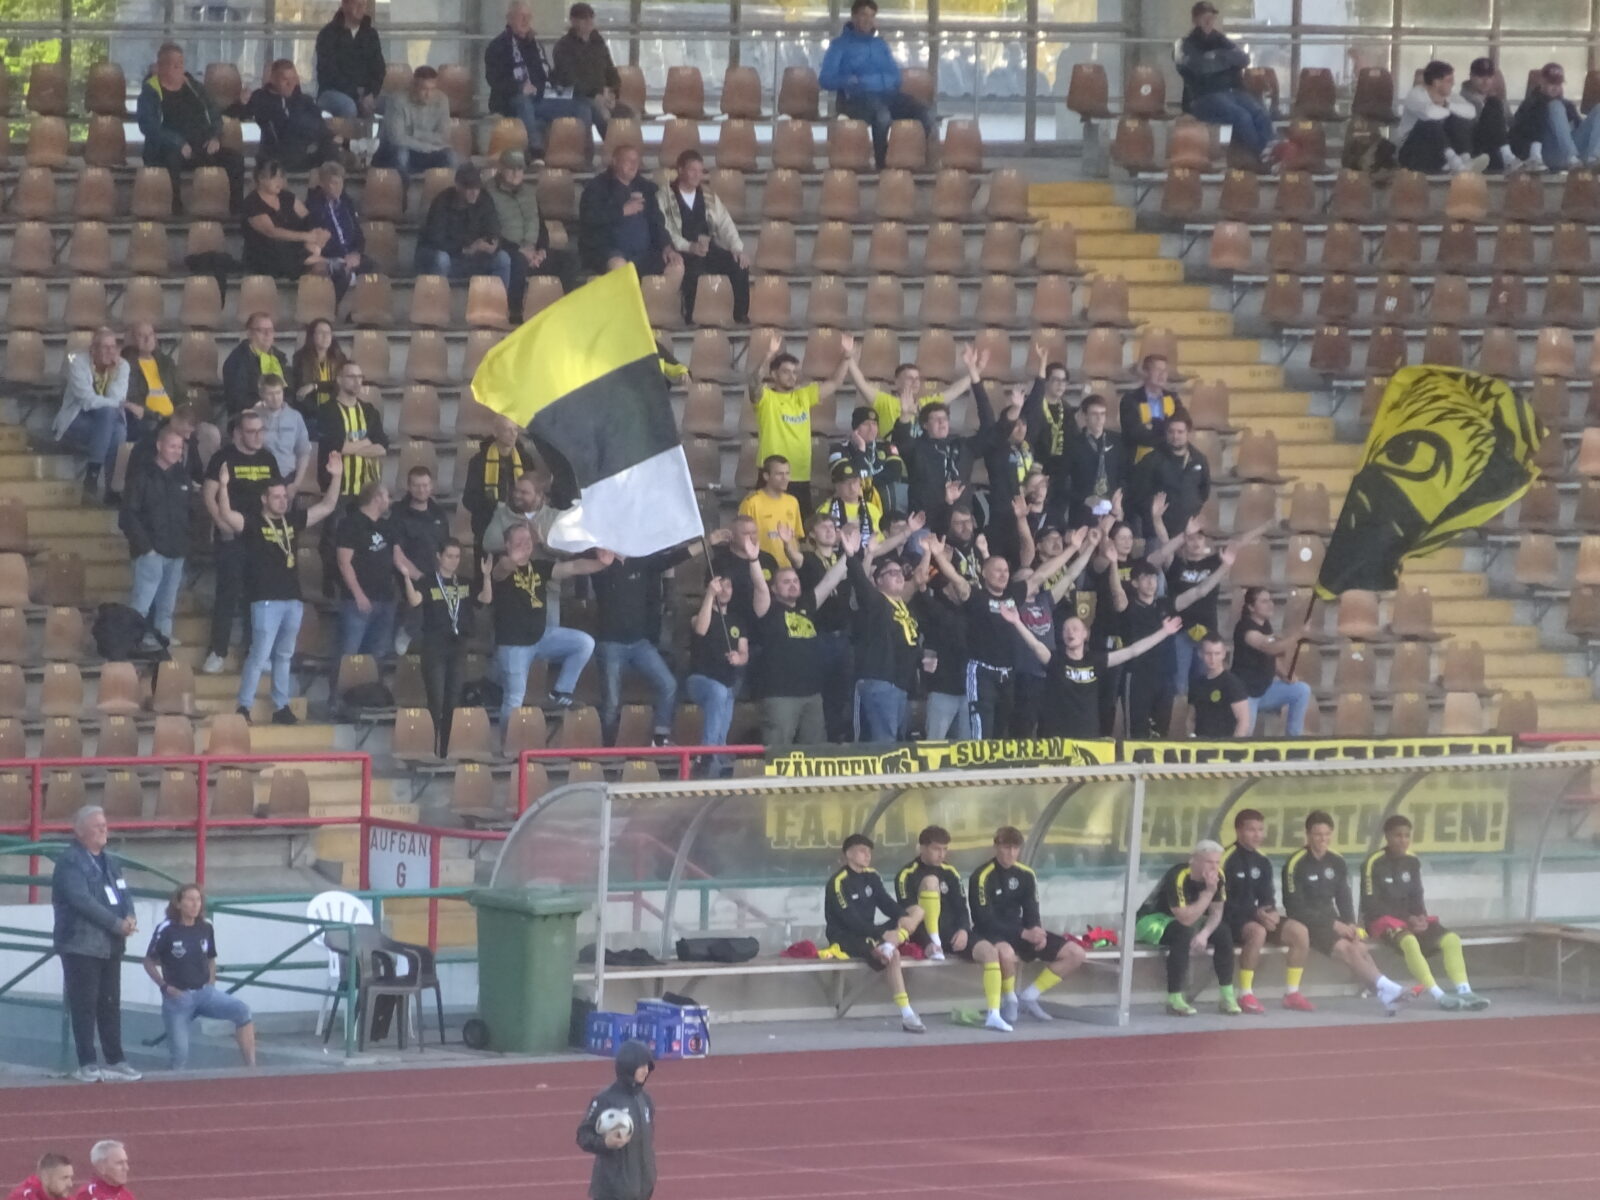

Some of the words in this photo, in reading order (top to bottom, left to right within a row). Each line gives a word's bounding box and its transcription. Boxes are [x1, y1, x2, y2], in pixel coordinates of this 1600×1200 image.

[957, 737, 1066, 767] SUPCREW
[1255, 802, 1505, 847] GETATEN!
[369, 827, 430, 857] AUFGAN
